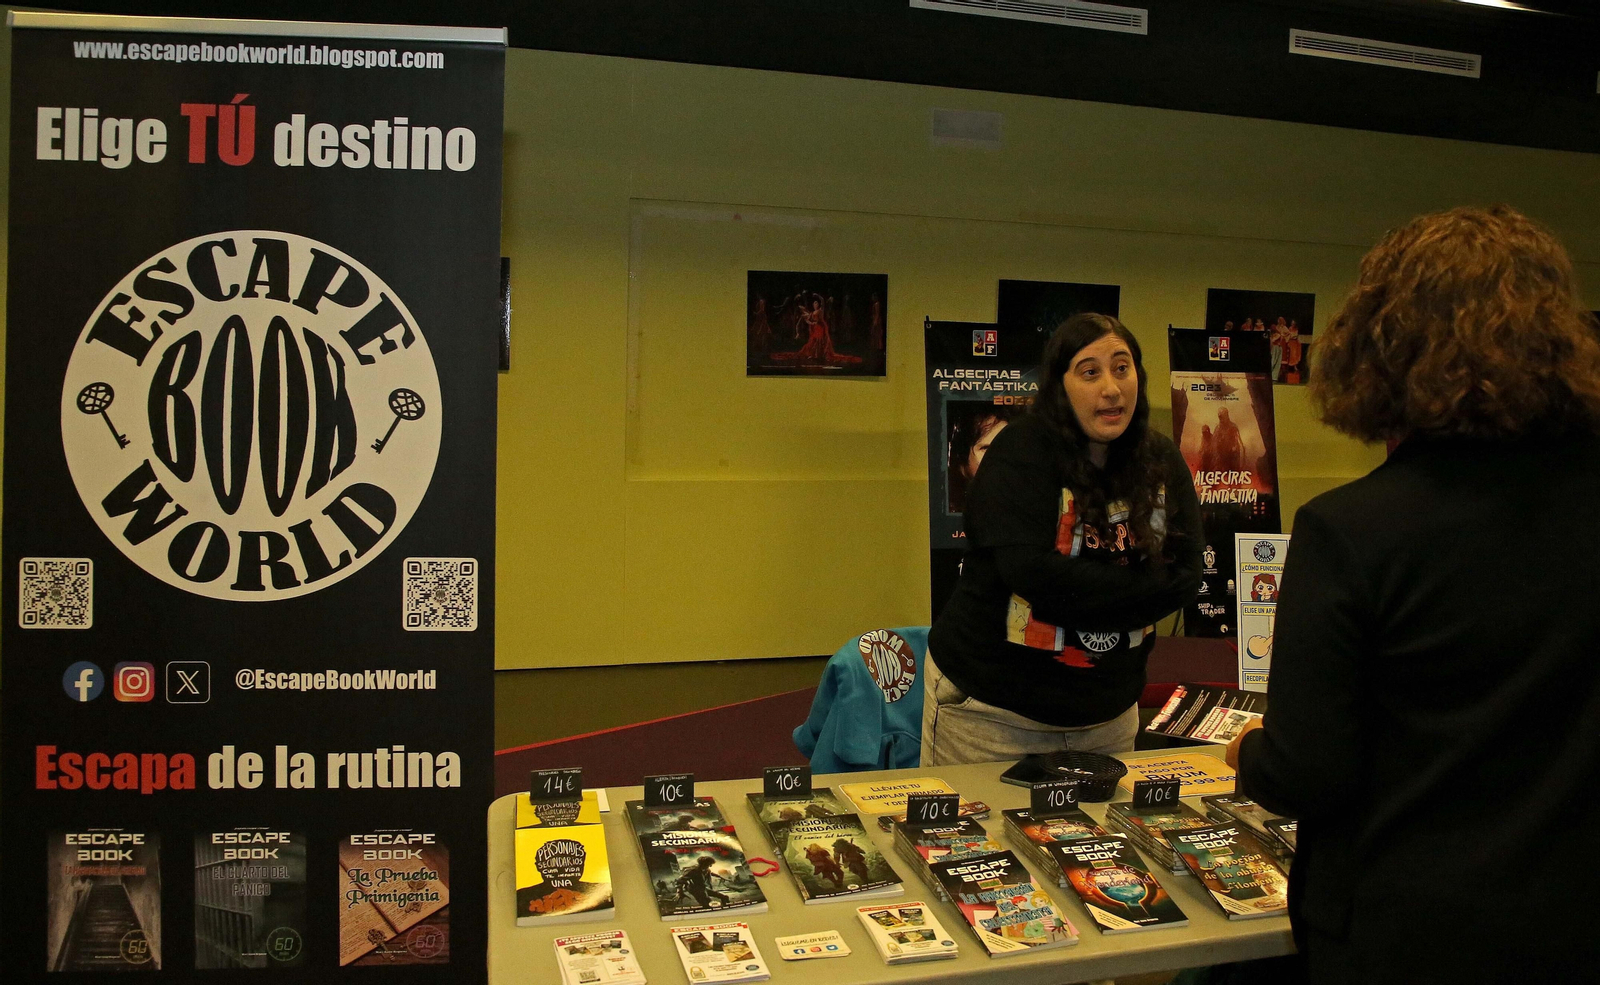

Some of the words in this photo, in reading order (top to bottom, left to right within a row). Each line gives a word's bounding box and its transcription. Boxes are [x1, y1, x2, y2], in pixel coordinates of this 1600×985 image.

[73, 39, 444, 70] www.escapebookworld.blogspot.com
[36, 106, 168, 169] Elige
[181, 93, 256, 166] TÚ
[274, 114, 477, 172] destino
[86, 237, 416, 366] ESCAPE
[986, 333, 995, 342] A
[1220, 339, 1228, 348] A
[986, 345, 995, 354] F
[1220, 350, 1228, 359] F
[932, 368, 1021, 380] ALGECIRAS
[939, 379, 1040, 392] FANTÁSTIKA
[1191, 383, 1222, 392] 2023
[148, 313, 357, 517] BOOK
[1193, 469, 1252, 487] ALGECIRAS
[1200, 485, 1258, 505] FANTÁSTIKA
[101, 458, 397, 591] WORLD
[1244, 606, 1258, 614] ELIGE
[1081, 632, 1119, 651] WORLD
[235, 668, 437, 692] @EscapeBookWorld
[35, 745, 197, 794] Escapa
[208, 745, 264, 789] de
[276, 745, 316, 788] la
[327, 745, 462, 789] rutina
[1147, 760, 1189, 768] ACEPTA
[776, 773, 802, 791] 10€
[1145, 770, 1208, 781] BIZUM
[543, 775, 576, 794] 14€
[870, 784, 911, 793] LLÉVATE
[659, 784, 685, 802] 10€
[860, 792, 906, 801] EJEMPLAR
[1047, 788, 1076, 807] 10€
[1145, 786, 1172, 804] 10€
[920, 801, 951, 820] 10€
[921, 825, 968, 835] BOOK
[1279, 823, 1298, 832] ES
[65, 833, 145, 845] ESCAPE
[212, 832, 291, 844] ESCAPE
[350, 833, 436, 846] ESCAPE
[651, 835, 732, 847] SECUNDARIAS
[662, 829, 717, 840] MISIONES
[1178, 827, 1240, 843] ESCAPE
[1061, 841, 1125, 854] ESCAPE
[1192, 837, 1238, 850] BOOK
[77, 850, 133, 861] BOOK
[223, 848, 279, 860] BOOK
[363, 849, 423, 861] BOOK
[537, 840, 585, 861] PERSONAJES
[1075, 850, 1122, 862] BOOK
[212, 866, 225, 879] EL
[228, 866, 269, 879] CUARTO
[270, 865, 290, 879] DEL
[946, 858, 1011, 876] ESCAPE
[347, 868, 373, 888] La
[375, 866, 439, 888] Prueba
[961, 868, 1008, 883] BOOK
[1204, 872, 1218, 880] de
[1220, 871, 1233, 879] la
[232, 879, 271, 897] PÁNICO
[551, 879, 573, 888] UNA
[345, 888, 440, 909] Primigenia
[128, 940, 148, 954] 60
[275, 937, 294, 951] 60
[415, 934, 436, 948] 60
